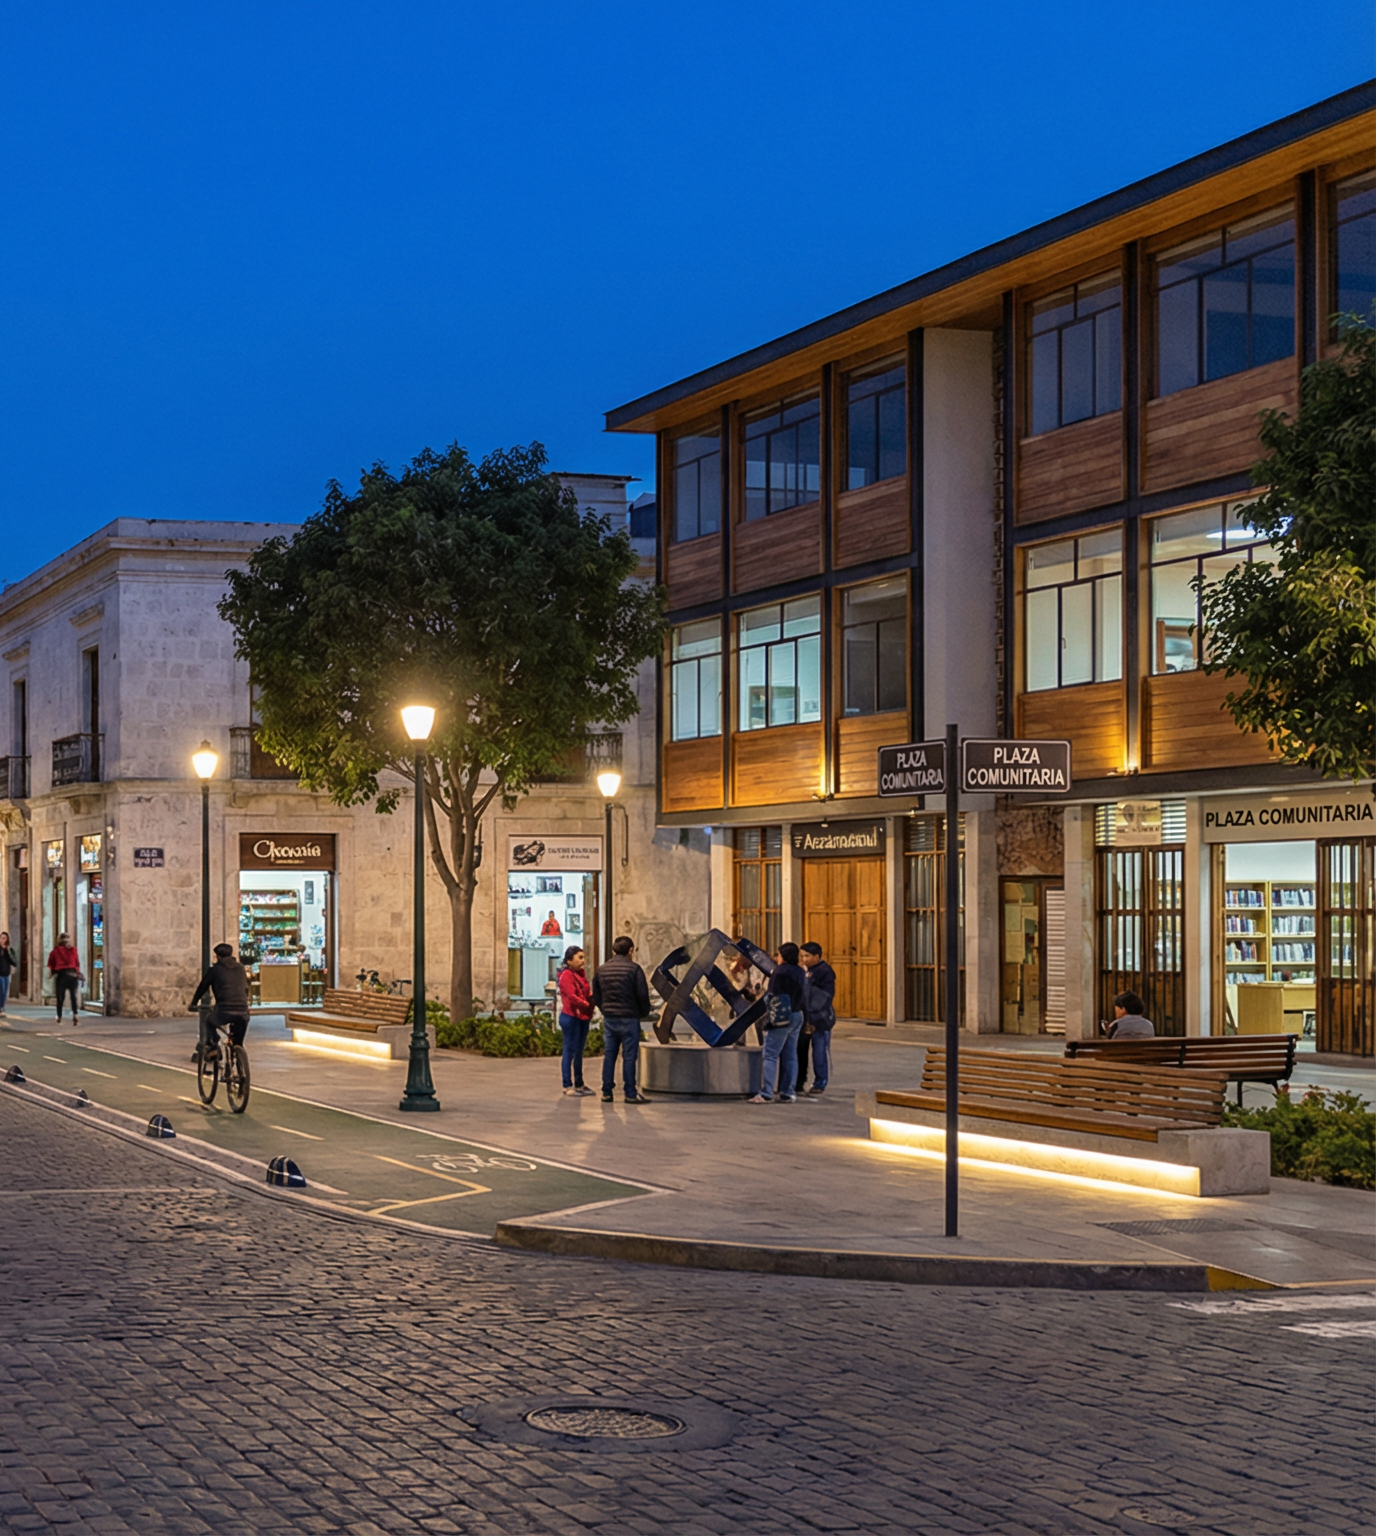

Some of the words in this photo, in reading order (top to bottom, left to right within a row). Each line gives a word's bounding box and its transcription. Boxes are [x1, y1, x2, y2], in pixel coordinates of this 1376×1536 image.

[896, 749, 928, 769] PLAZA
[993, 746, 1042, 765] PLAZA
[967, 767, 1065, 786] COMUNITARIA
[1205, 810, 1255, 828] PLAZA
[1258, 803, 1374, 826] COMUNITARIA
